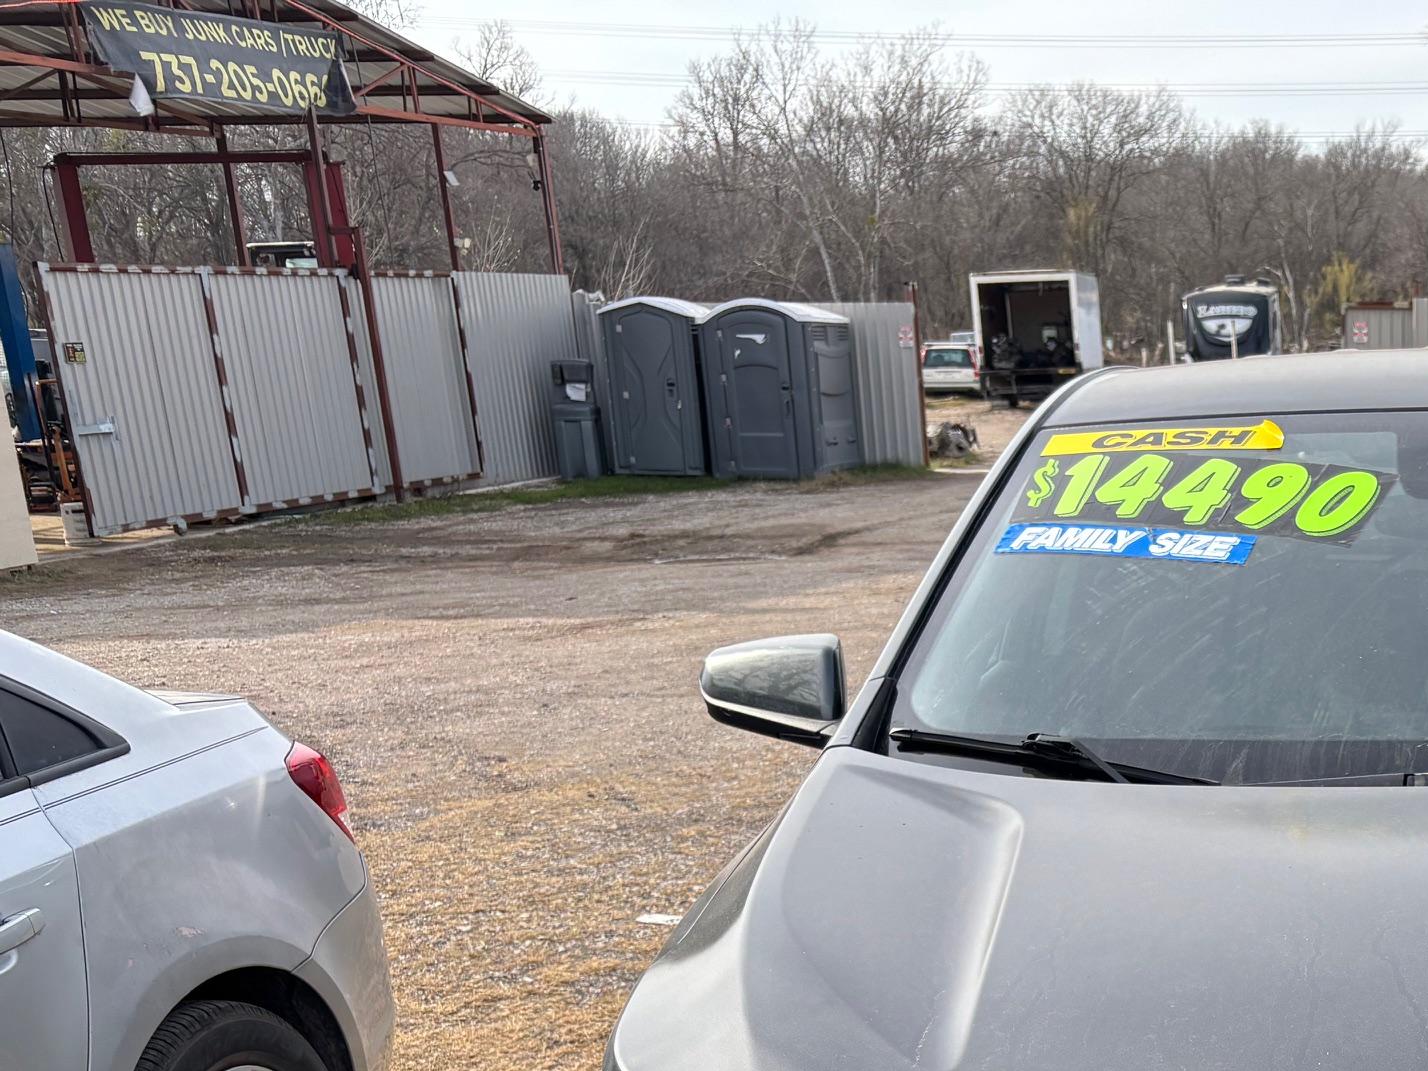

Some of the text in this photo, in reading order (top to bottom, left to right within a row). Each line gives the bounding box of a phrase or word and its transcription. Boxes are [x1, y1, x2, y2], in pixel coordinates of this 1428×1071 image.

[90, 6, 138, 32] WE
[134, 10, 178, 37] BUY
[181, 18, 233, 45] JUNK
[231, 24, 277, 53] CARS
[139, 50, 329, 108] 737-205-066
[1091, 429, 1256, 450] CASH
[1026, 454, 1381, 537] $14490
[1010, 527, 1241, 559] FAMILY SIZE
